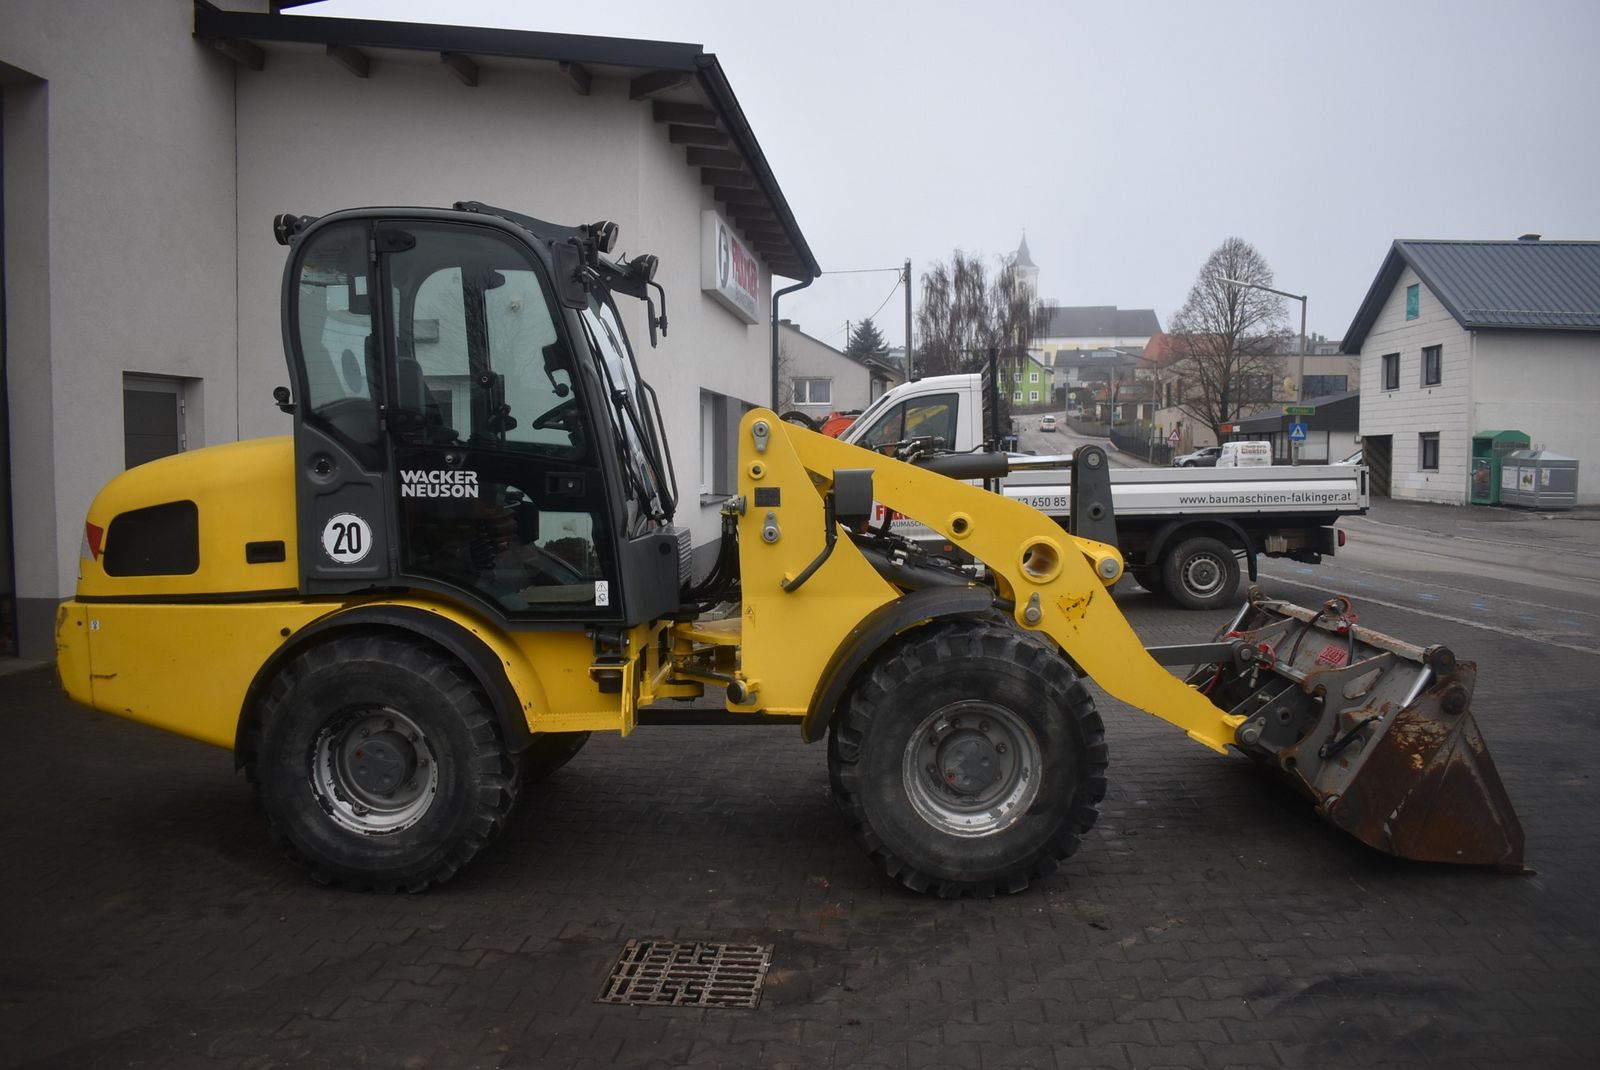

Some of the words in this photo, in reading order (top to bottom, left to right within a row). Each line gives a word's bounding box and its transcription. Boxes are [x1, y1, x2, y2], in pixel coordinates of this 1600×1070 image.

[400, 470, 479, 484] WACKER
[401, 484, 479, 498] NEUSON
[1032, 497, 1051, 507] 650
[1053, 496, 1067, 507] 85
[1179, 492, 1352, 505] www.baumaschinen-falkinger.at
[332, 522, 362, 554] 20
